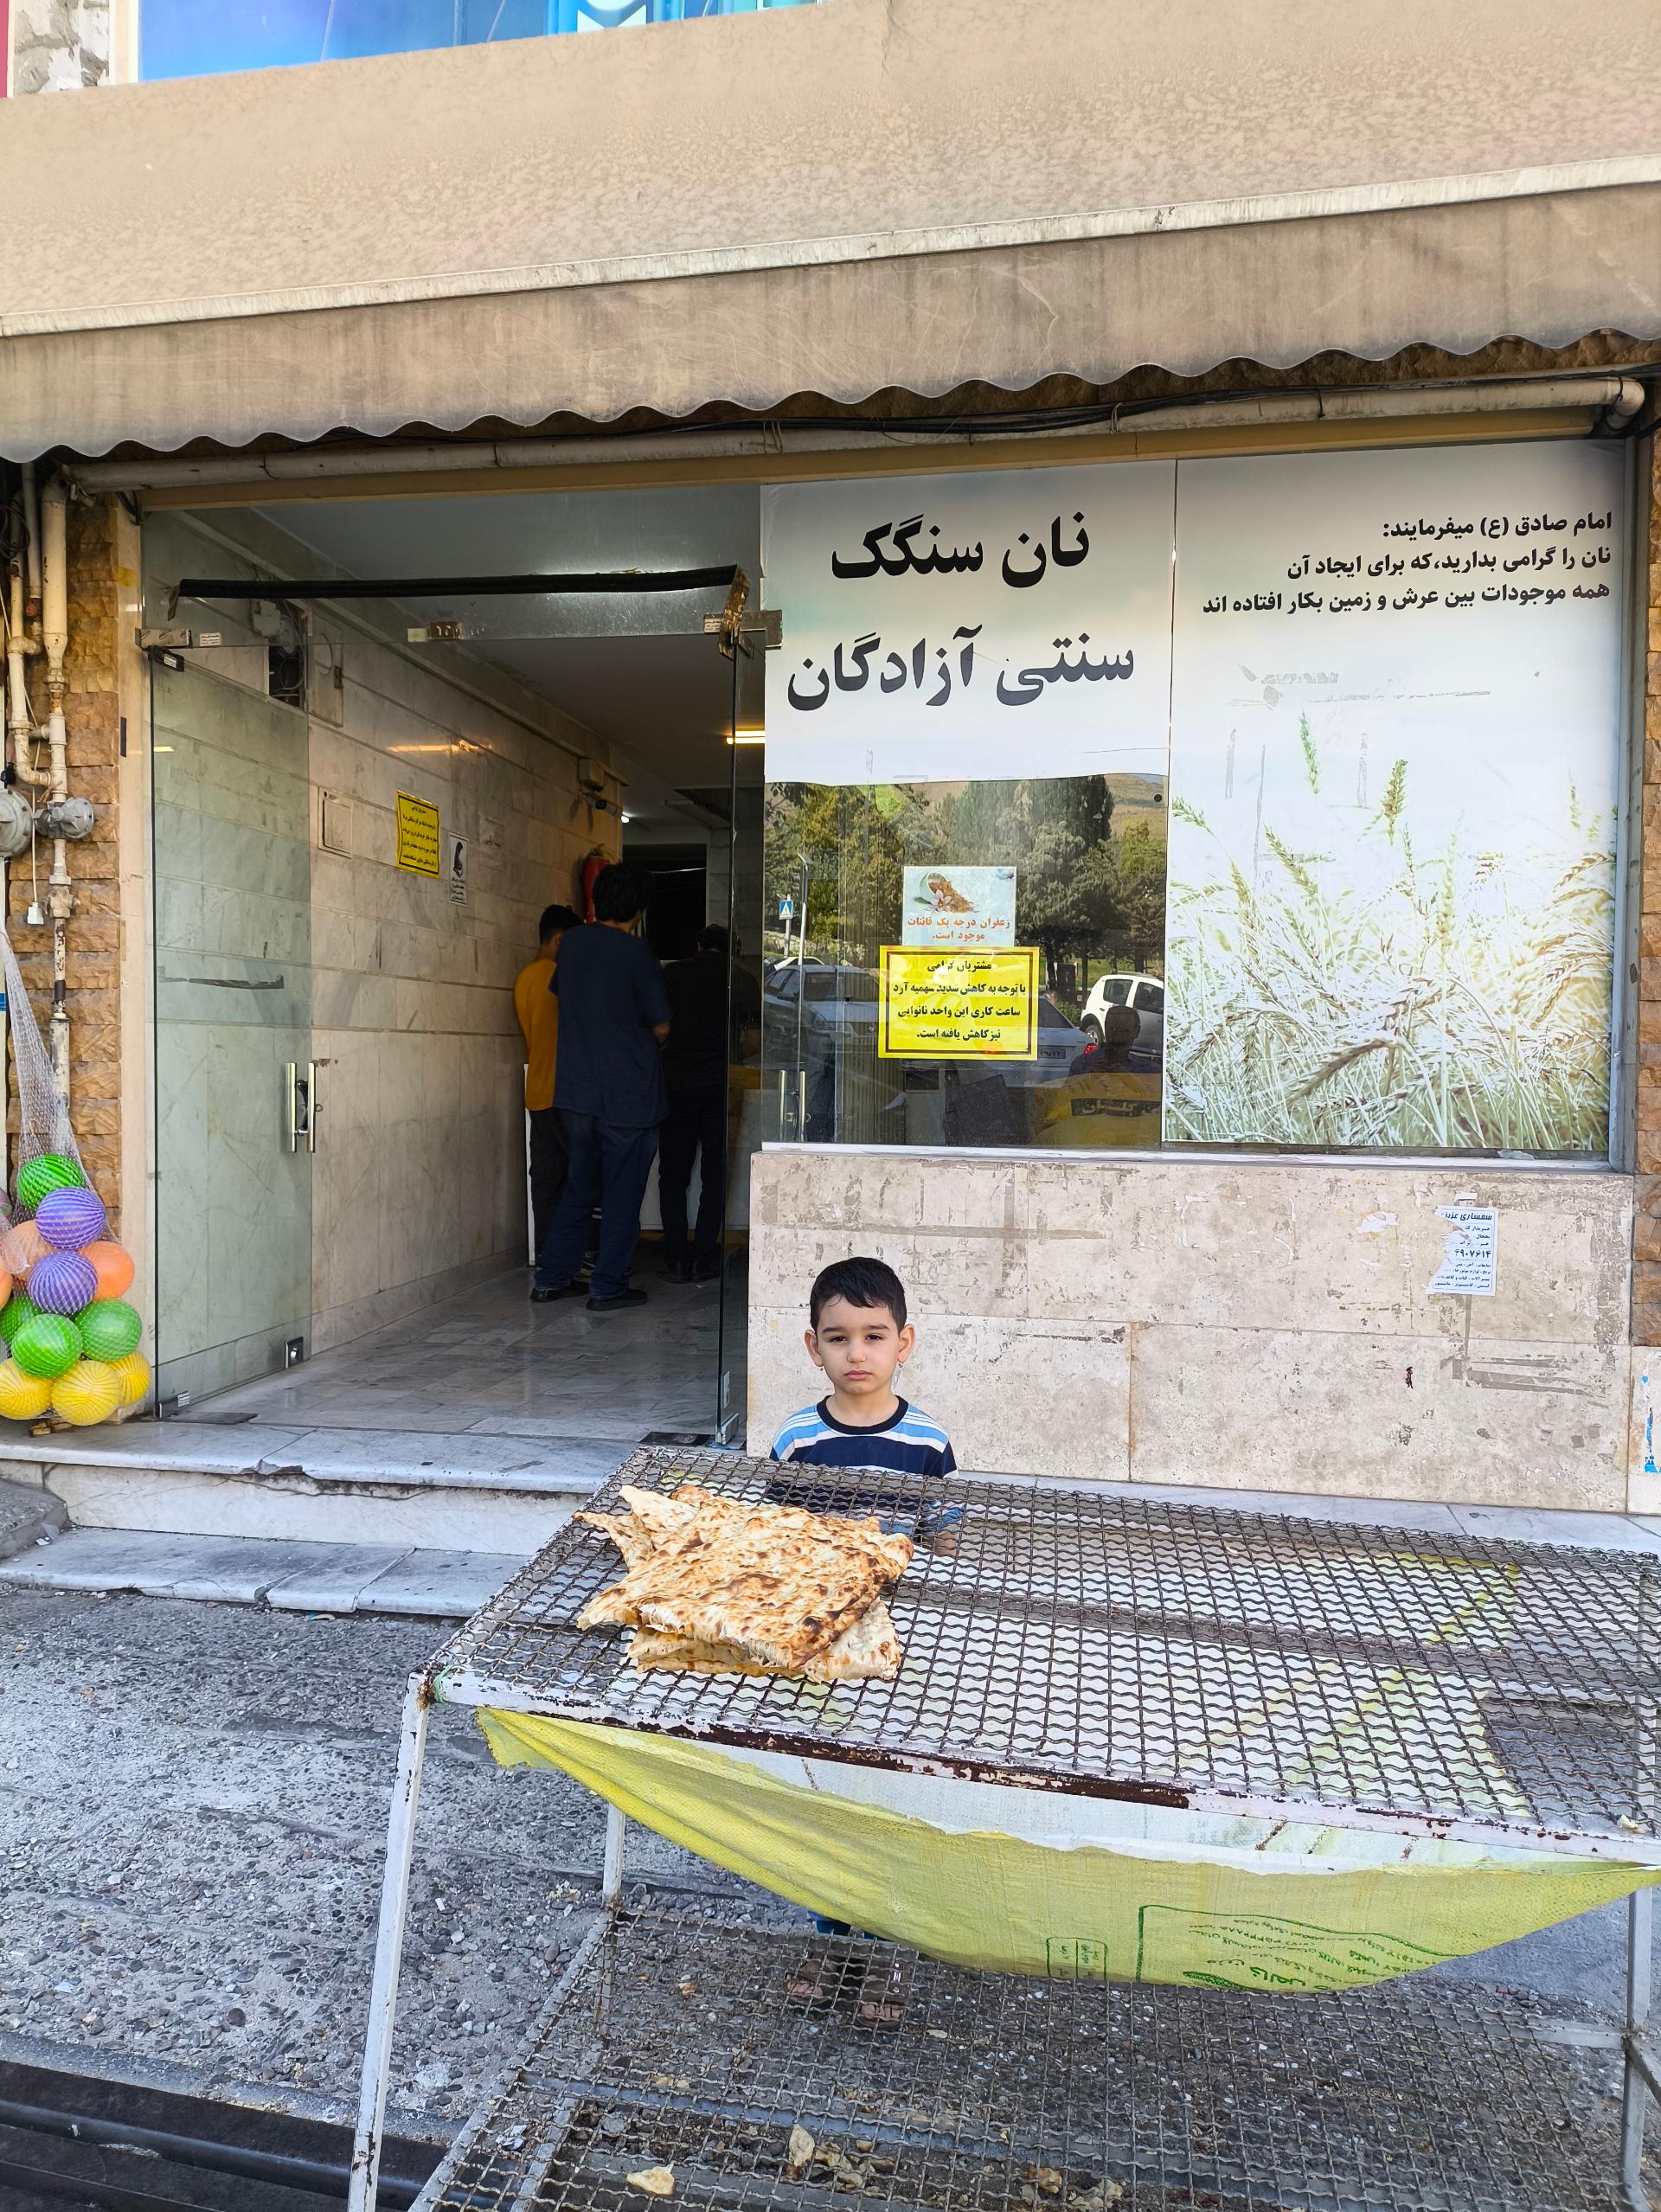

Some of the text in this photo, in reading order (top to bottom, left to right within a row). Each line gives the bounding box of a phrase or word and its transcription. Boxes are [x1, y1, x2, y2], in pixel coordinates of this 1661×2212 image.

[1383, 512, 1613, 541] امام صادق (ع) میفرمایند:
[832, 512, 1089, 587] نان سنگک
[1504, 547, 1555, 572] گرامی
[1563, 548, 1574, 569] را
[1581, 546, 1611, 567] نان
[1288, 555, 1310, 579] آن
[1316, 555, 1361, 578] ایجاد
[1368, 555, 1404, 576] برای
[1203, 582, 1609, 614] همه موجودات بین عرش و زمین بکار افتاده اند
[788, 625, 1133, 710] سنتی آزادگان
[936, 918, 949, 927] یک
[954, 919, 976, 928] درجه
[980, 918, 1010, 928] زعفران
[959, 933, 985, 941] موجود
[957, 960, 991, 972] مشتریان
[893, 982, 909, 994] آرد
[910, 984, 934, 994] سهمیه
[960, 984, 986, 995] کاهش
[988, 985, 997, 995] به
[997, 984, 1018, 996] توجه
[1019, 983, 1026, 996] با
[898, 1006, 1021, 1019] ساعت کاری این واحد نانوایی
[917, 1029, 1001, 1041] نیز کاهش یافته است.
[1460, 1212, 1492, 1221] سمساری
[1249, 1966, 1306, 1986] خالص
